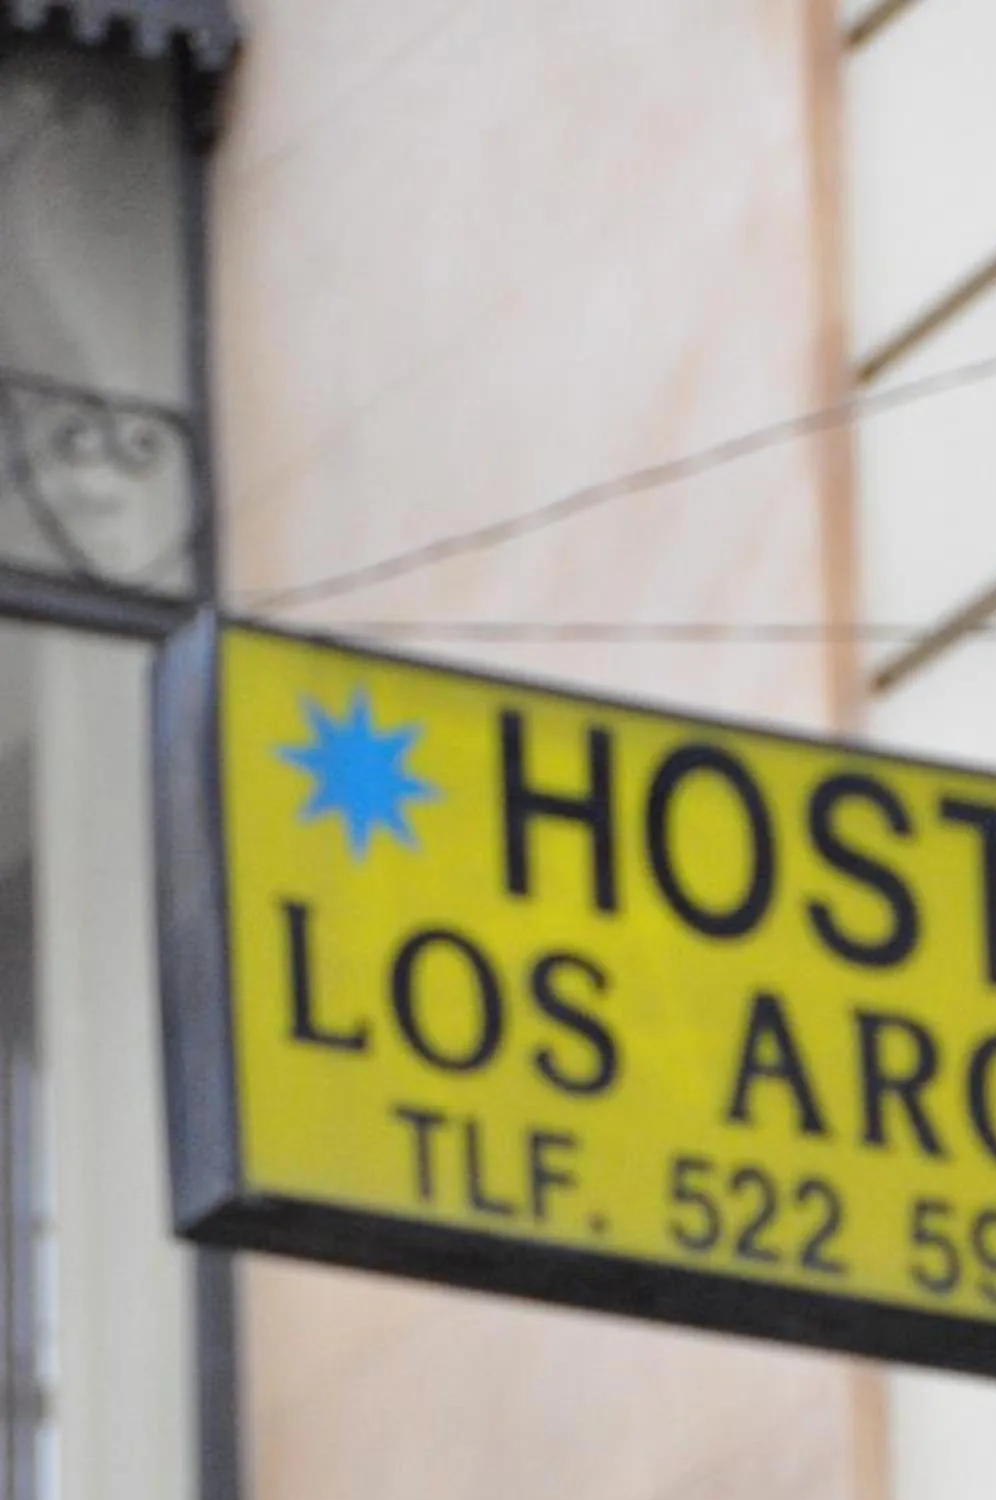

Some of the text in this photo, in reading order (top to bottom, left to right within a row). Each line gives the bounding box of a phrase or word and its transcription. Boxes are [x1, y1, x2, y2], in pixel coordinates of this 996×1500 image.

[282, 900, 619, 1096] LOS
[393, 1106, 608, 1234] TLF.
[670, 1156, 846, 1276] 522
